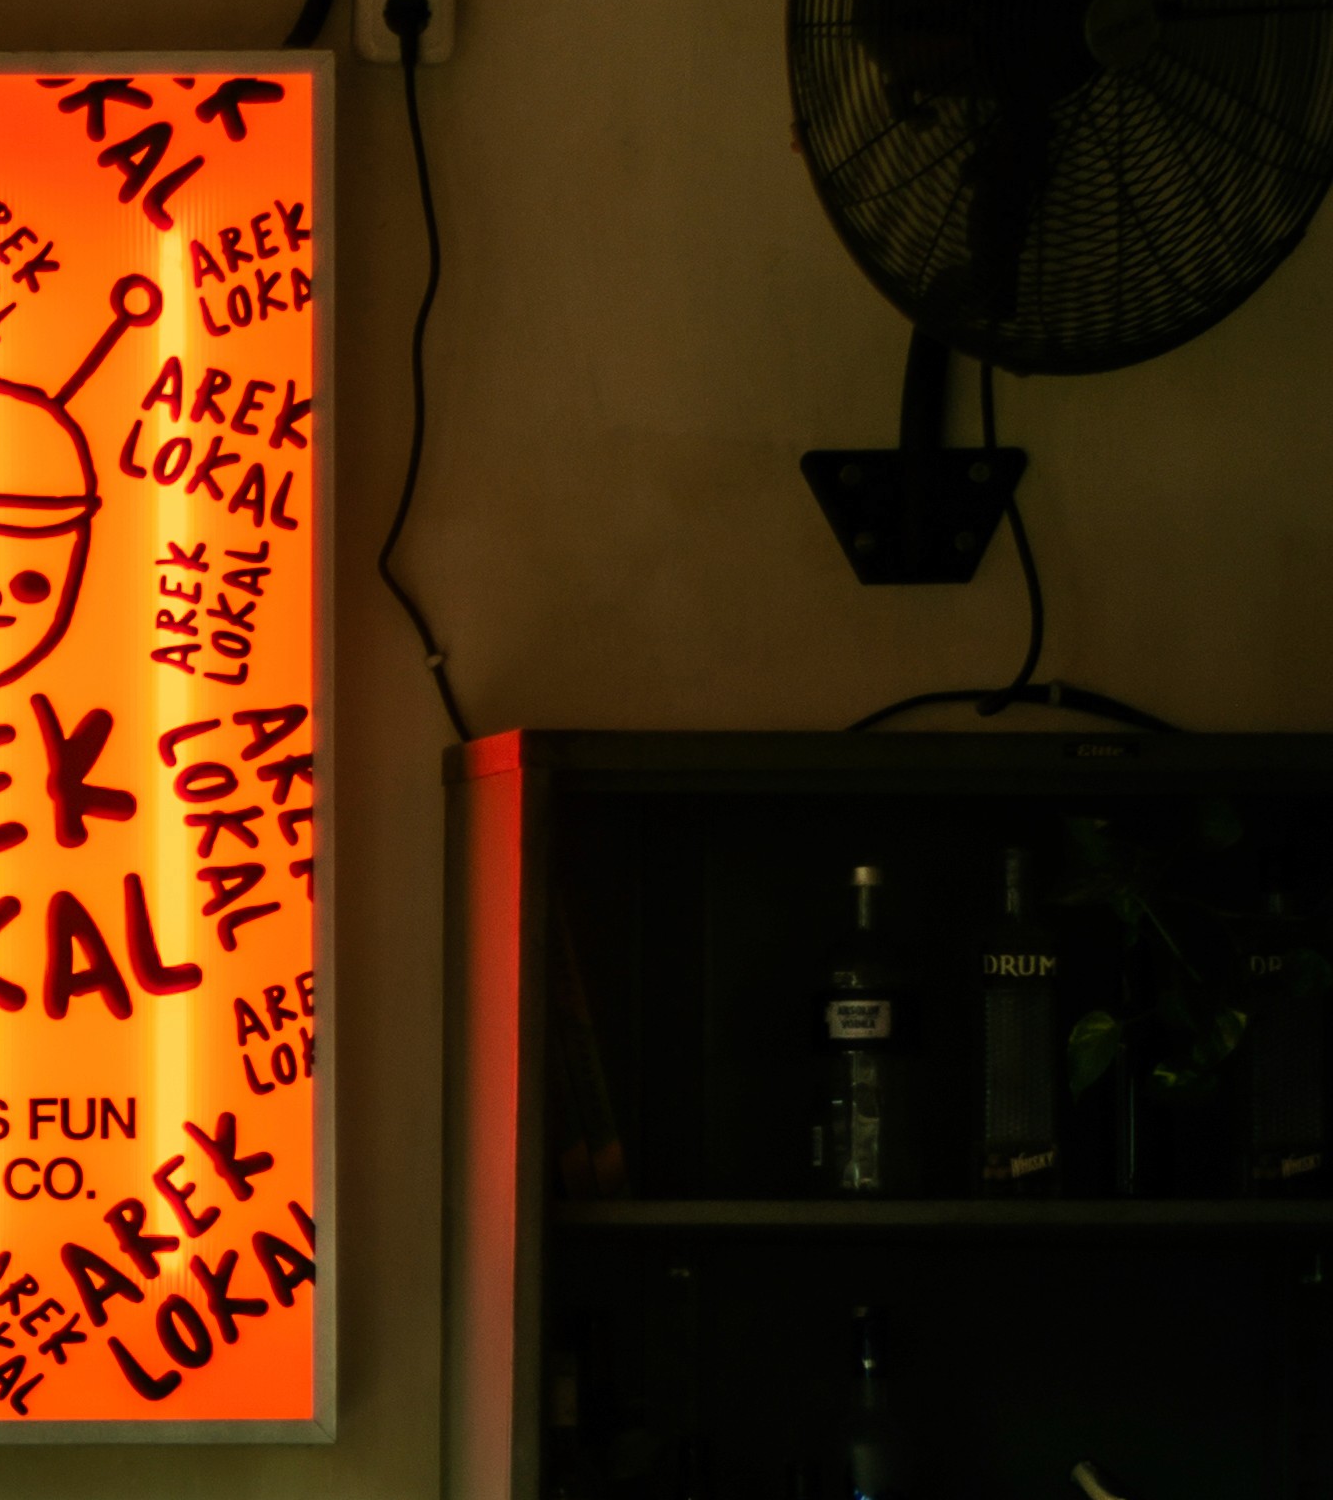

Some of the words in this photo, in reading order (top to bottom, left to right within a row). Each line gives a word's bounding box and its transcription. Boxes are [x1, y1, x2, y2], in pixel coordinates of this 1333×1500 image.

[190, 199, 312, 289] AREK
[139, 355, 313, 450] AREK
[119, 419, 300, 532] LOKAL
[150, 540, 210, 675] AREK
[202, 539, 271, 686] LOKAL
[157, 718, 282, 953] LOKAL
[983, 953, 1058, 978] DRUM
[29, 1097, 137, 1141] FUN
[2, 1156, 97, 1201] CO.
[60, 1111, 275, 1328] AREK
